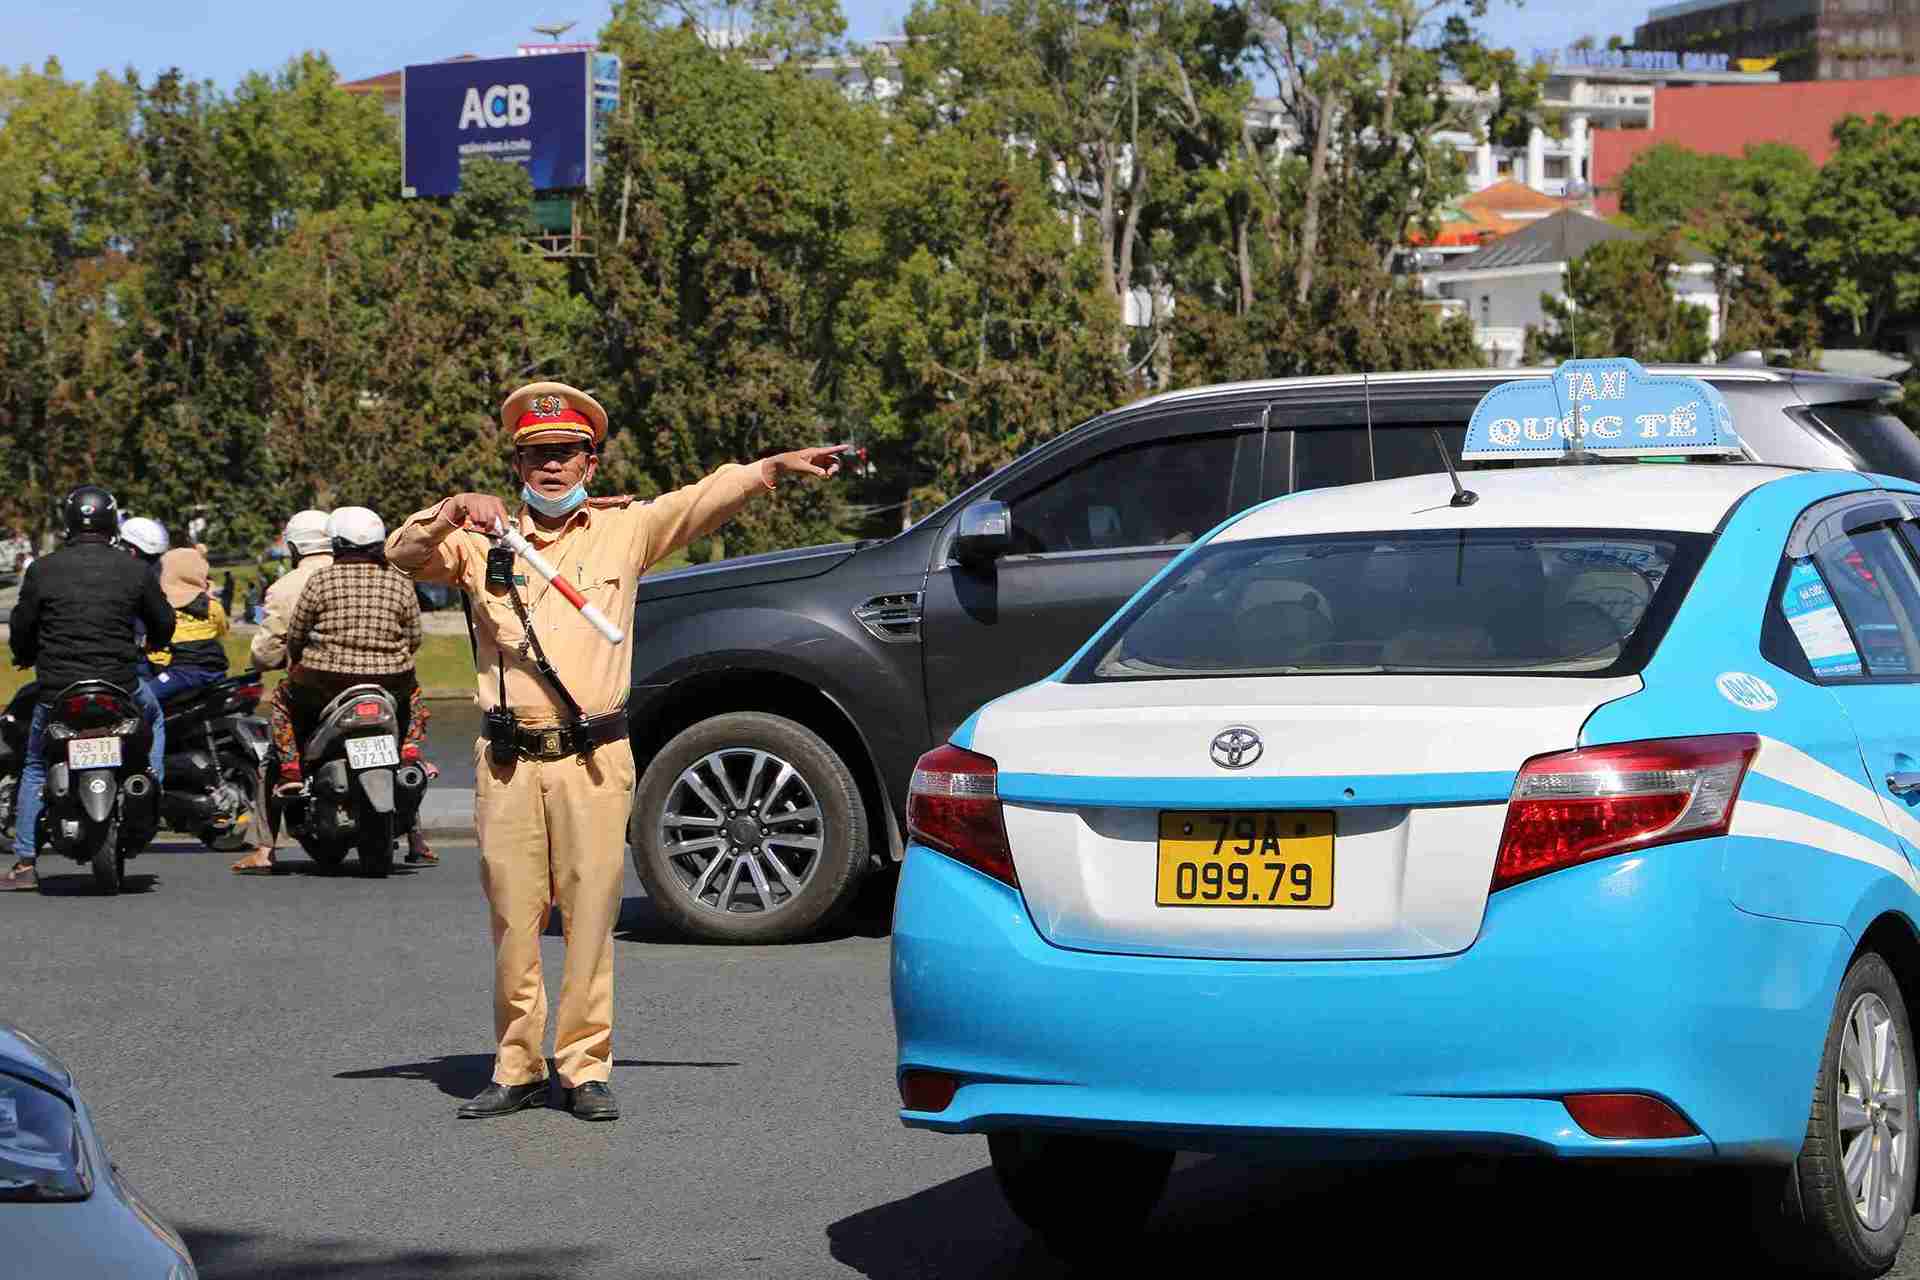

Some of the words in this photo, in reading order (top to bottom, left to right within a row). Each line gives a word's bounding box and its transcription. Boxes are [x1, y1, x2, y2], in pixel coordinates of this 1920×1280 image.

[458, 84, 531, 130] ACB
[1565, 370, 1627, 400] TAXI
[1490, 405, 1623, 445] QUỐC
[1637, 402, 1699, 437] TẾ
[1210, 816, 1281, 856] 79A
[1176, 861, 1313, 902] 099.79
